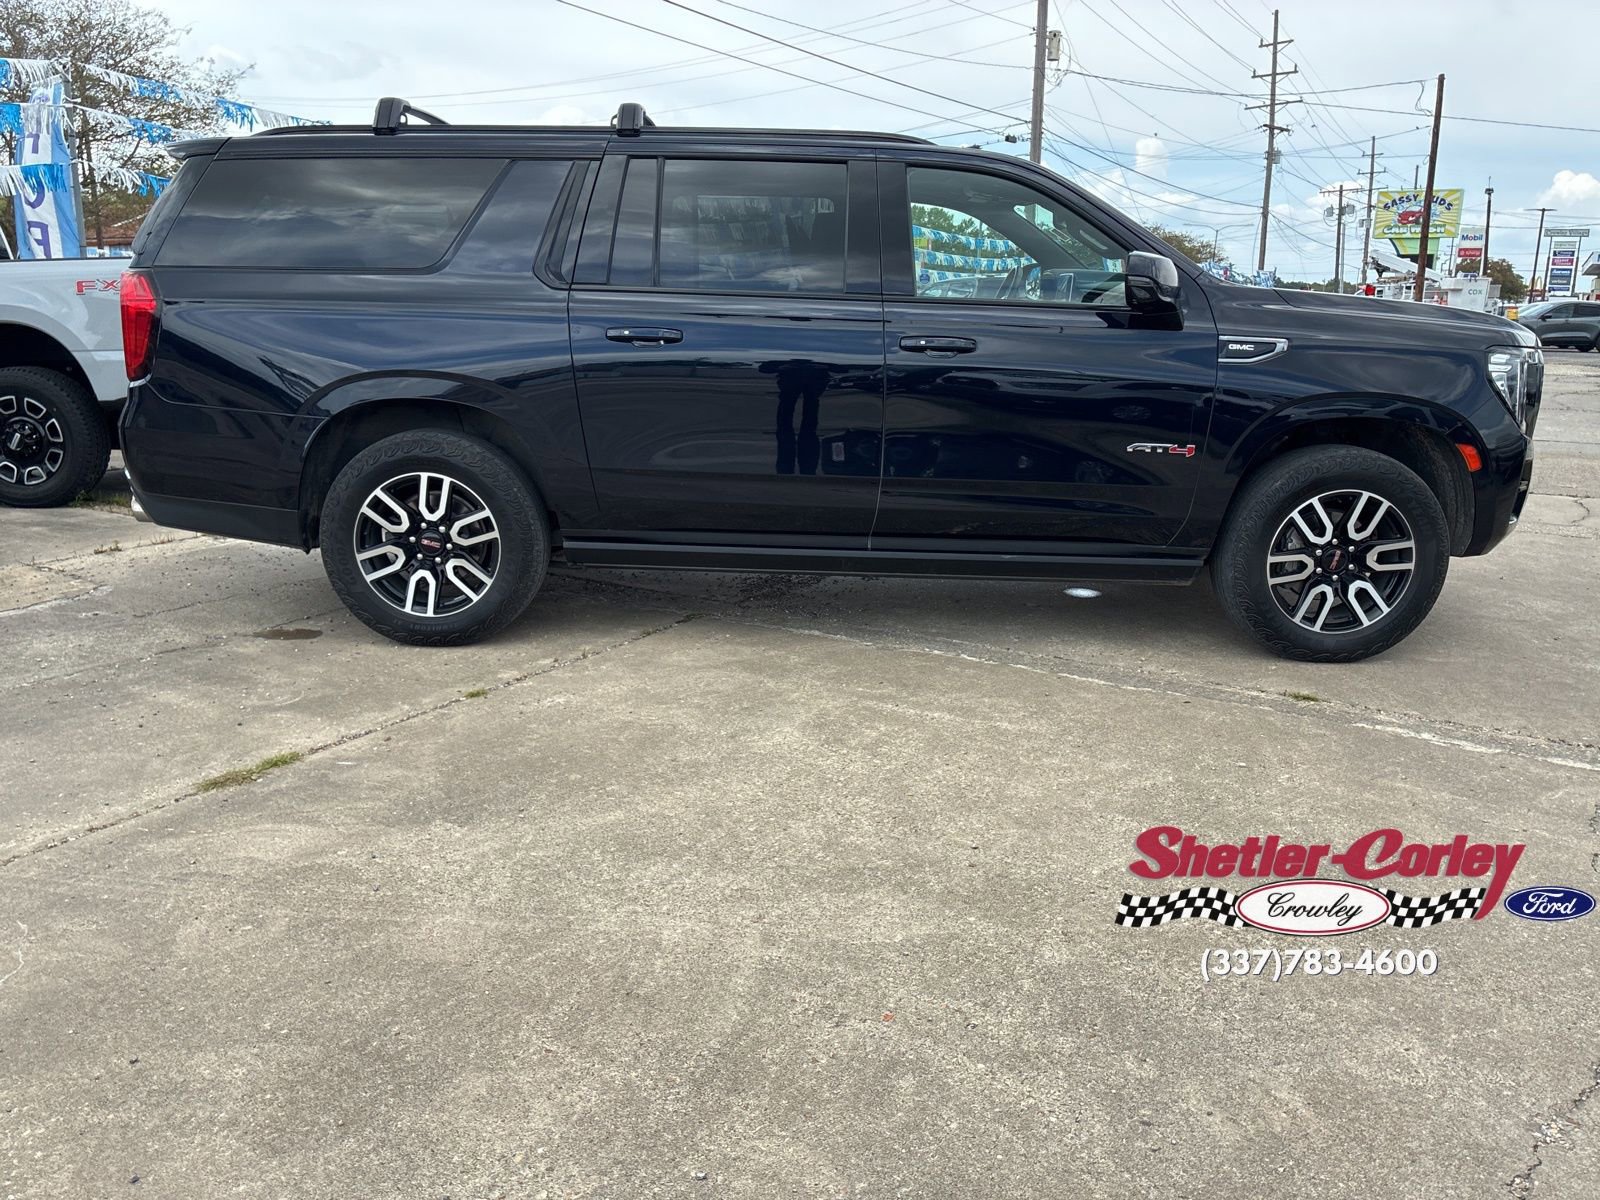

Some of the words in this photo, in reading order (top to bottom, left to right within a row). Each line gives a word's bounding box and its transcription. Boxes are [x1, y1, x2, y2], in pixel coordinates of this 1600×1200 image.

[1383, 194, 1419, 211] SASSY
[1410, 224, 1446, 233] WSH
[1126, 442, 1196, 457] AT4
